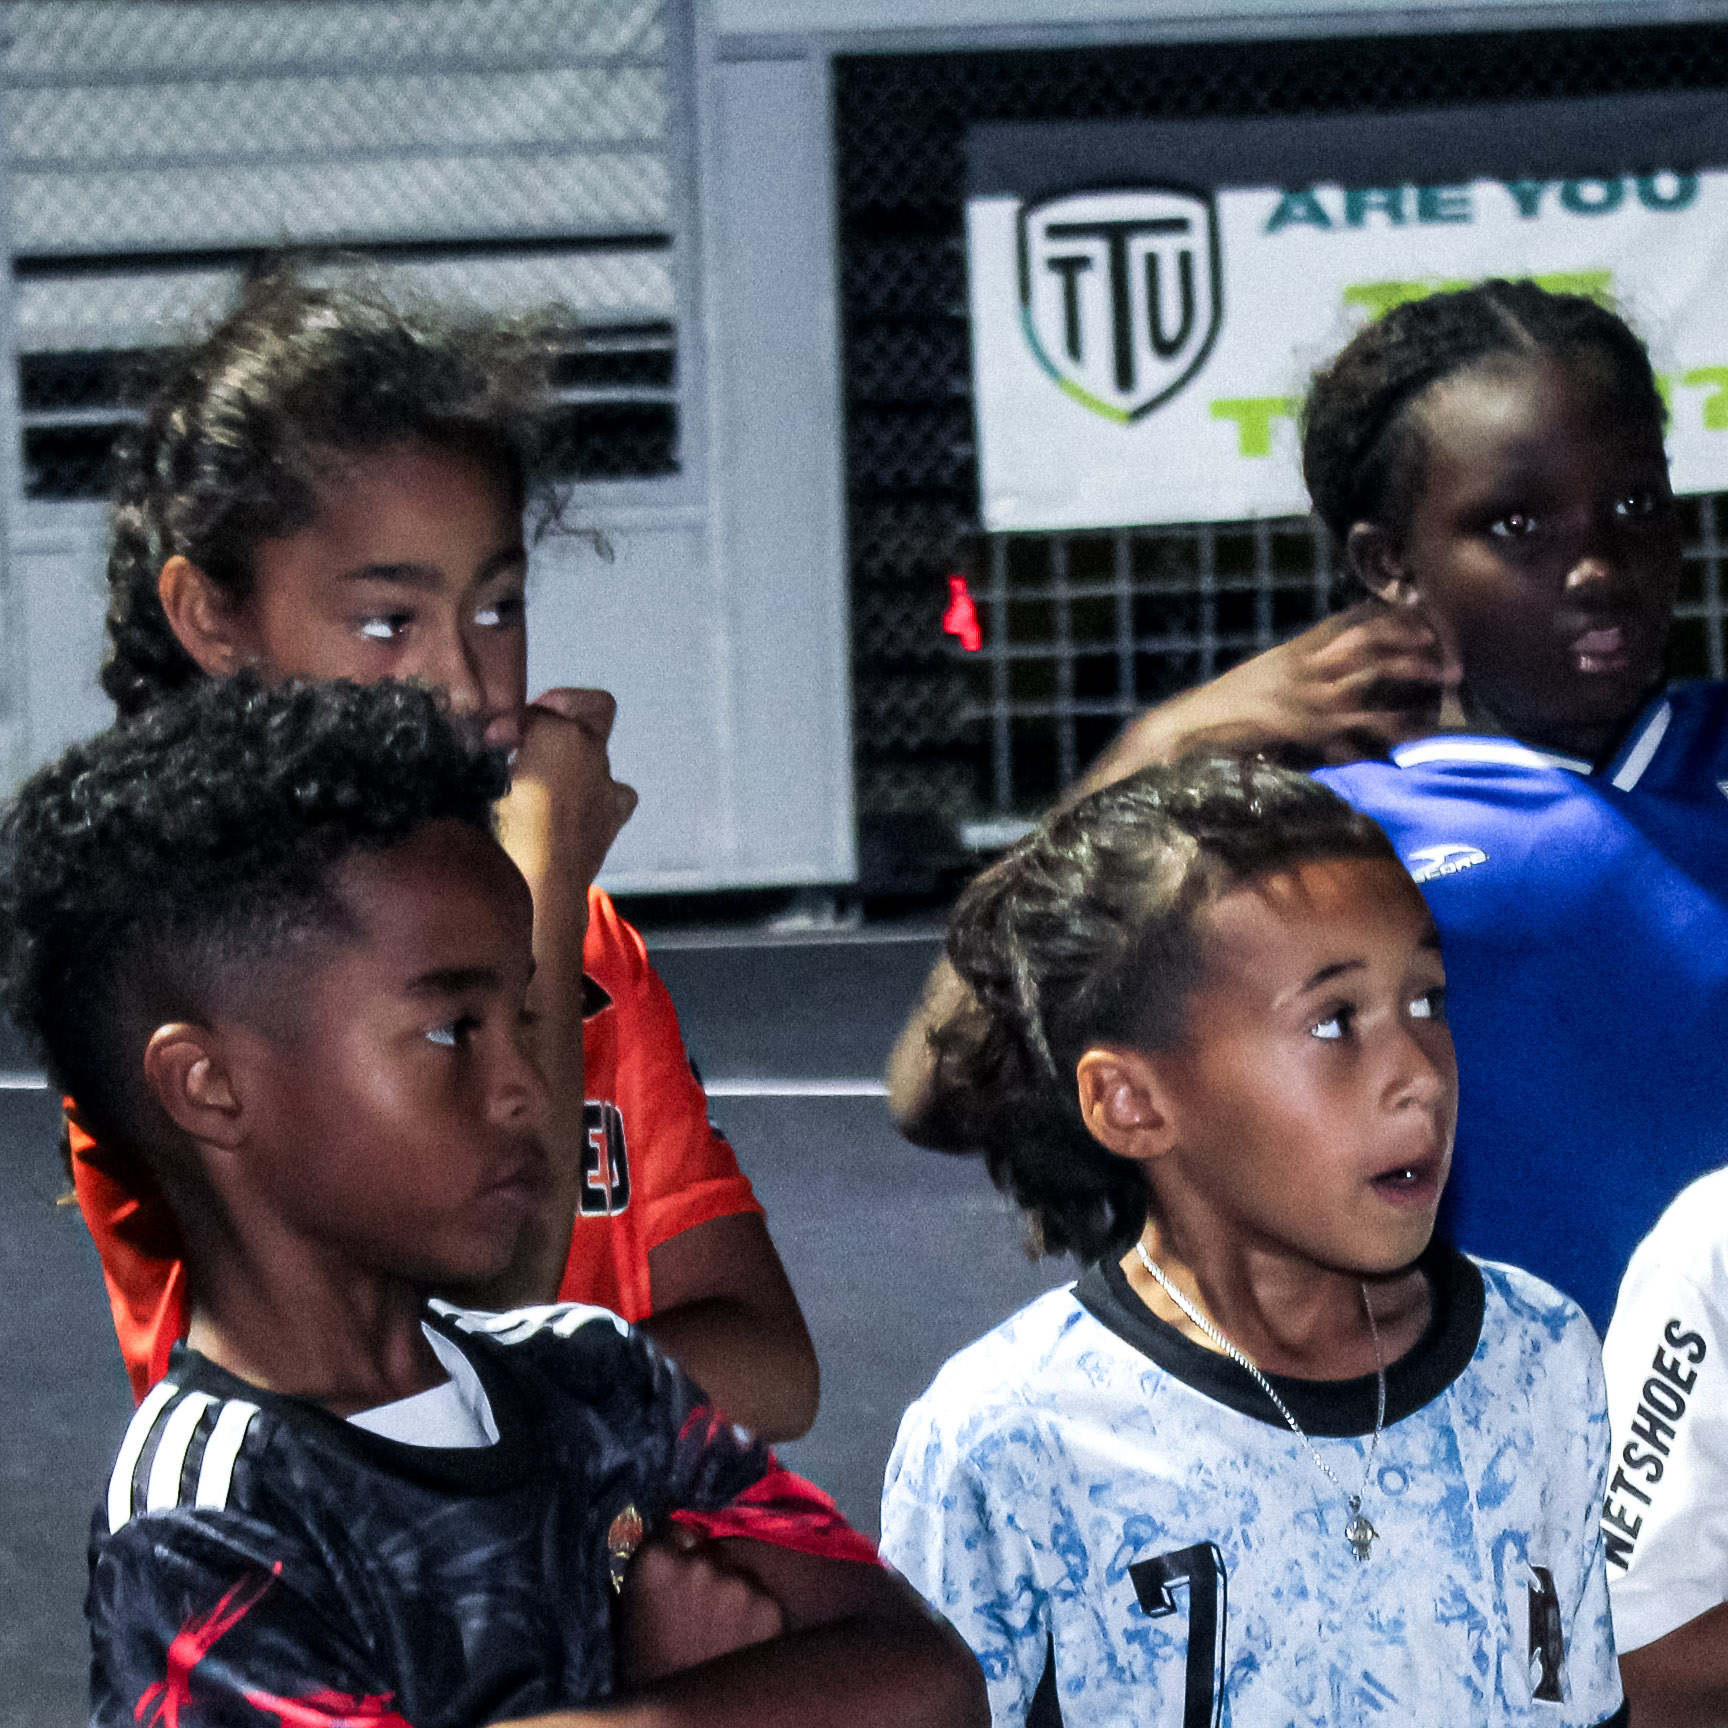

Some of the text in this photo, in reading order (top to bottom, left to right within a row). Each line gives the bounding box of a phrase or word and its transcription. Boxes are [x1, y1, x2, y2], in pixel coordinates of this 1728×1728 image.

[1265, 171, 1700, 236] ARE YOU
[1044, 216, 1192, 392] TTU
[1601, 1317, 1708, 1573] NETSHOES
